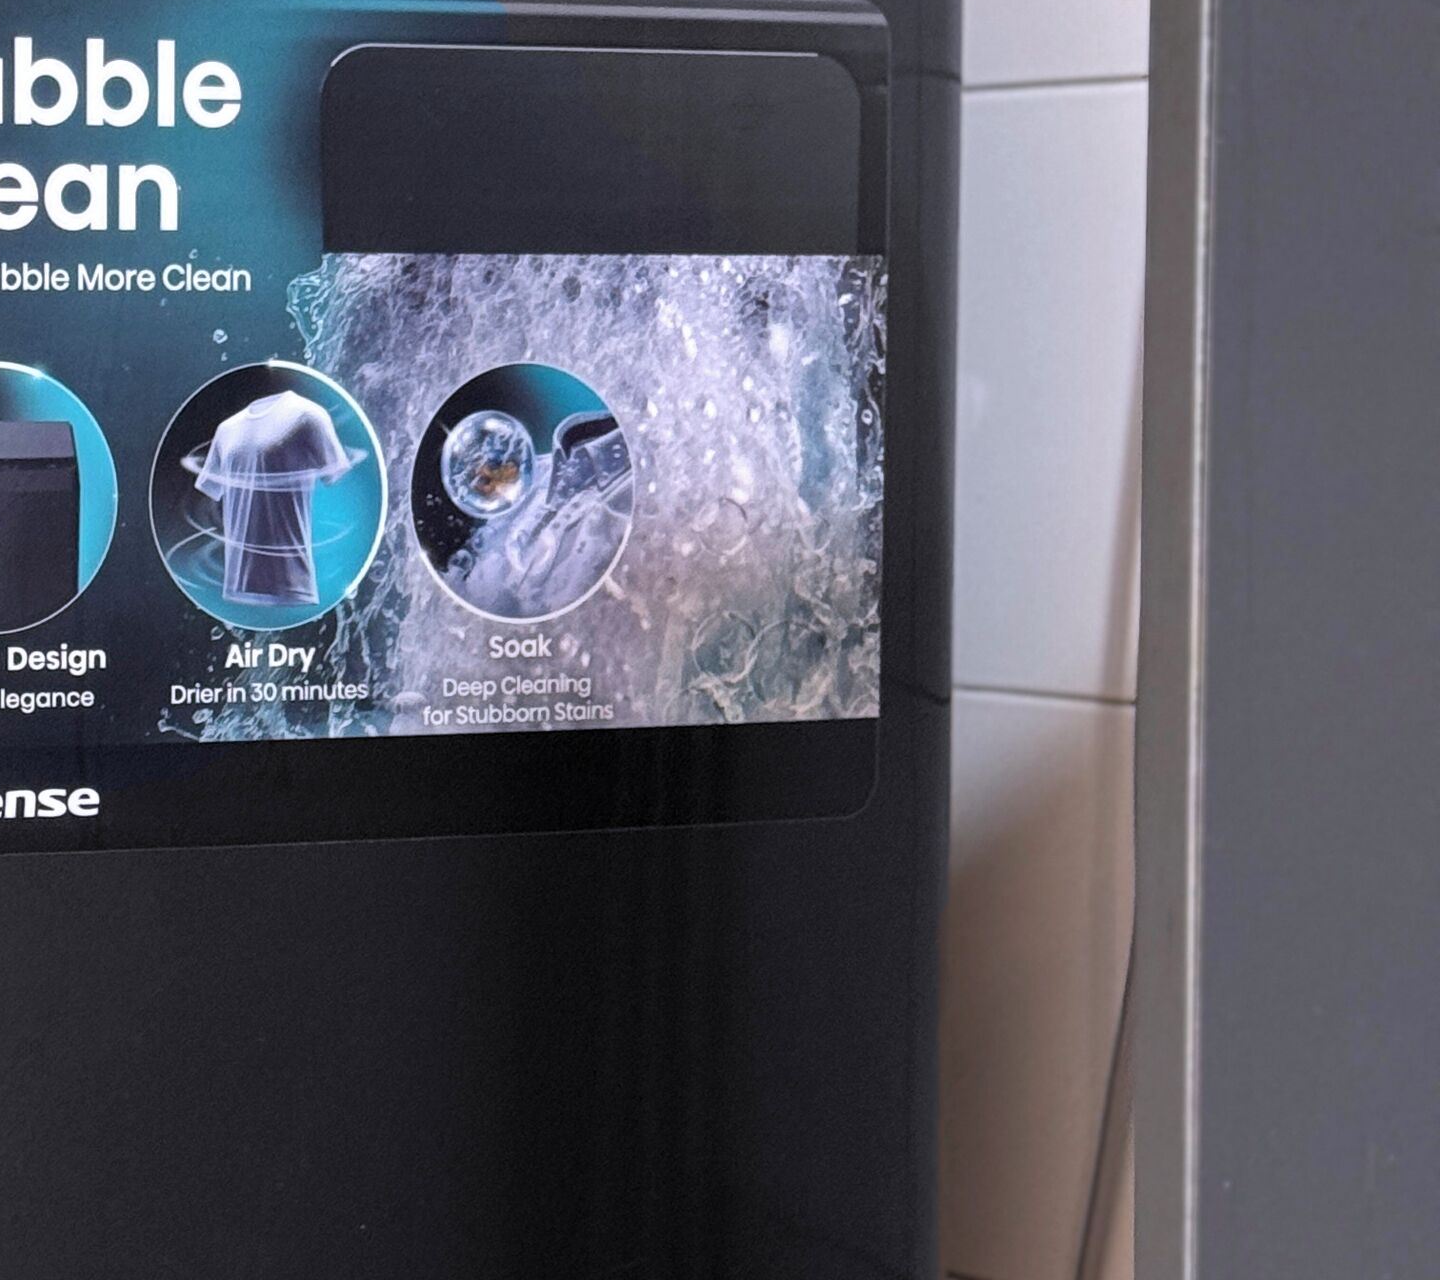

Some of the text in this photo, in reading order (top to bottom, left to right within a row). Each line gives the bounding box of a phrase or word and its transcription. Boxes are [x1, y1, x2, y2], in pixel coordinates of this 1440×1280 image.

[78, 263, 156, 291] More
[163, 263, 251, 292] Clean
[225, 642, 316, 673] Air Dry
[490, 634, 553, 658] Soak
[7, 643, 107, 676] Design
[171, 680, 369, 704] Drier in 30 minutes
[442, 674, 592, 700] Deep Cleaning
[423, 700, 614, 726] for Stubborn Stains
